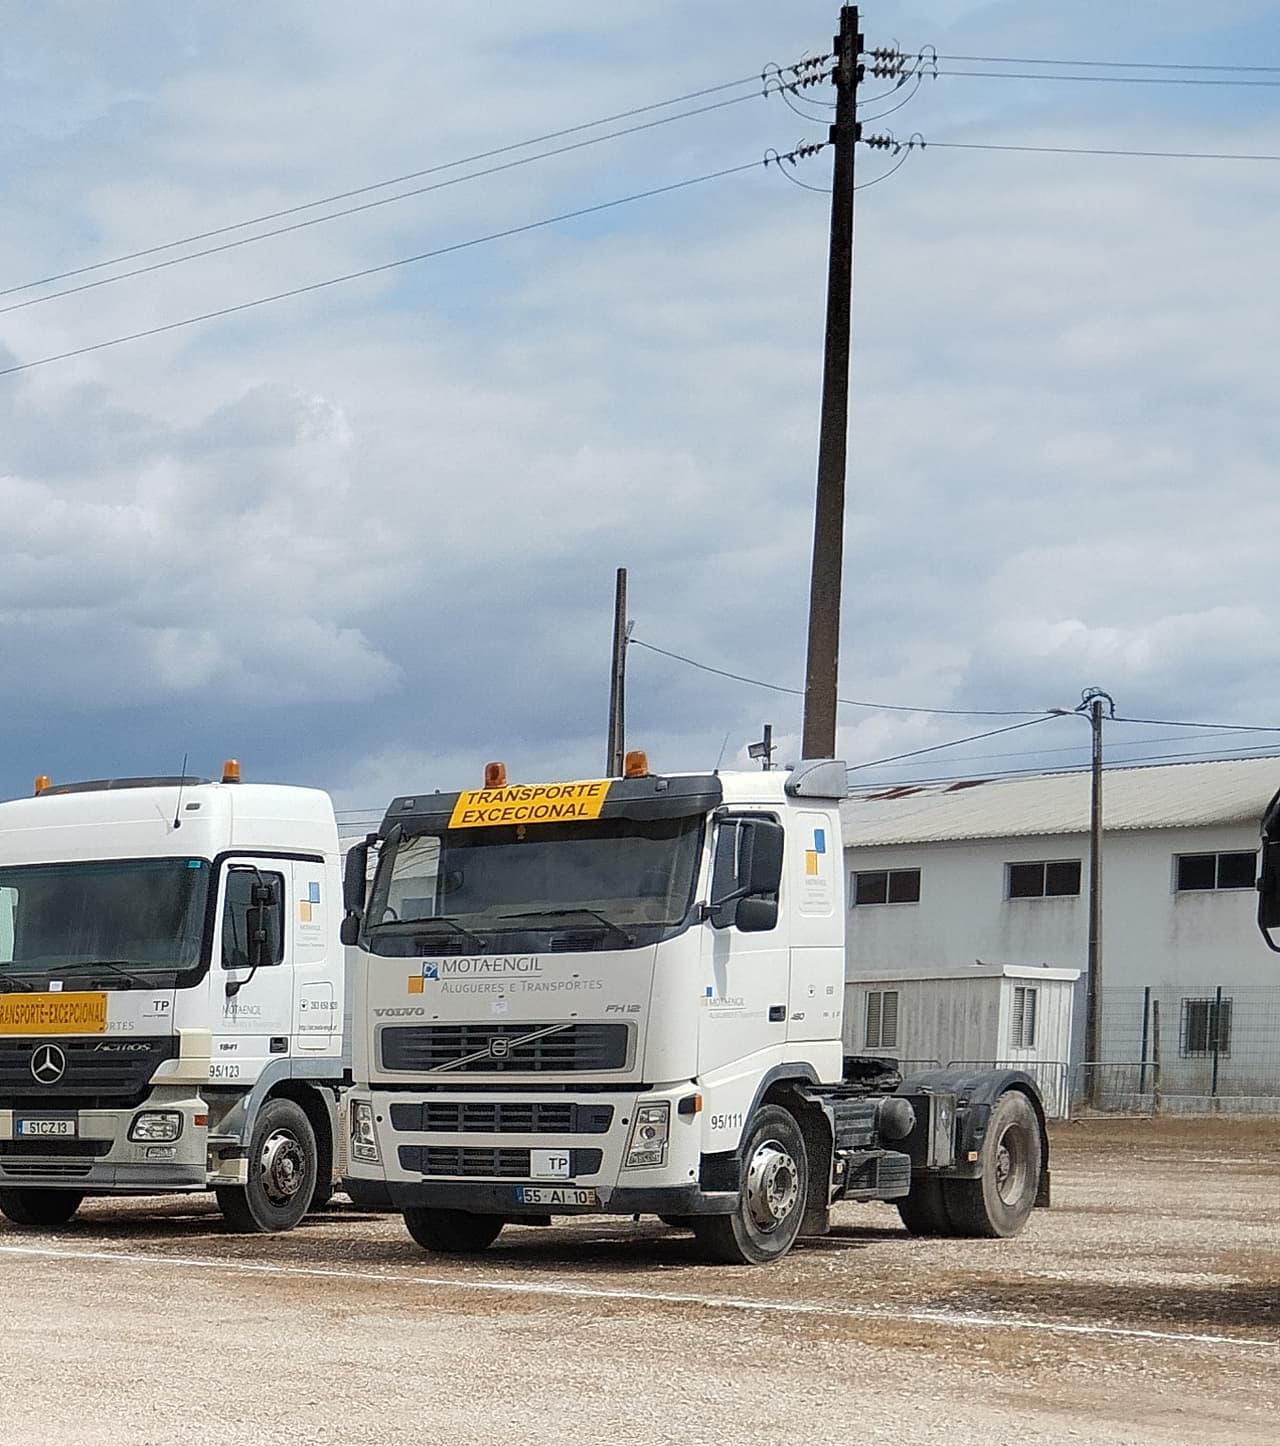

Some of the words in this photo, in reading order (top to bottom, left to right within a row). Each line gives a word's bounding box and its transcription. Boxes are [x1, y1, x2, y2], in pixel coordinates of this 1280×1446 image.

[466, 783, 603, 806] TRANSPORTE
[461, 802, 590, 824] EXCECIONAL
[441, 981, 505, 994] ALUGUERES
[520, 979, 603, 992] TRANSPORTES
[153, 1000, 169, 1012] TP
[373, 1007, 425, 1017] VOLVO
[209, 1064, 240, 1078] 95/123
[711, 1113, 743, 1130] 95/111
[548, 1157, 569, 1170] TP
